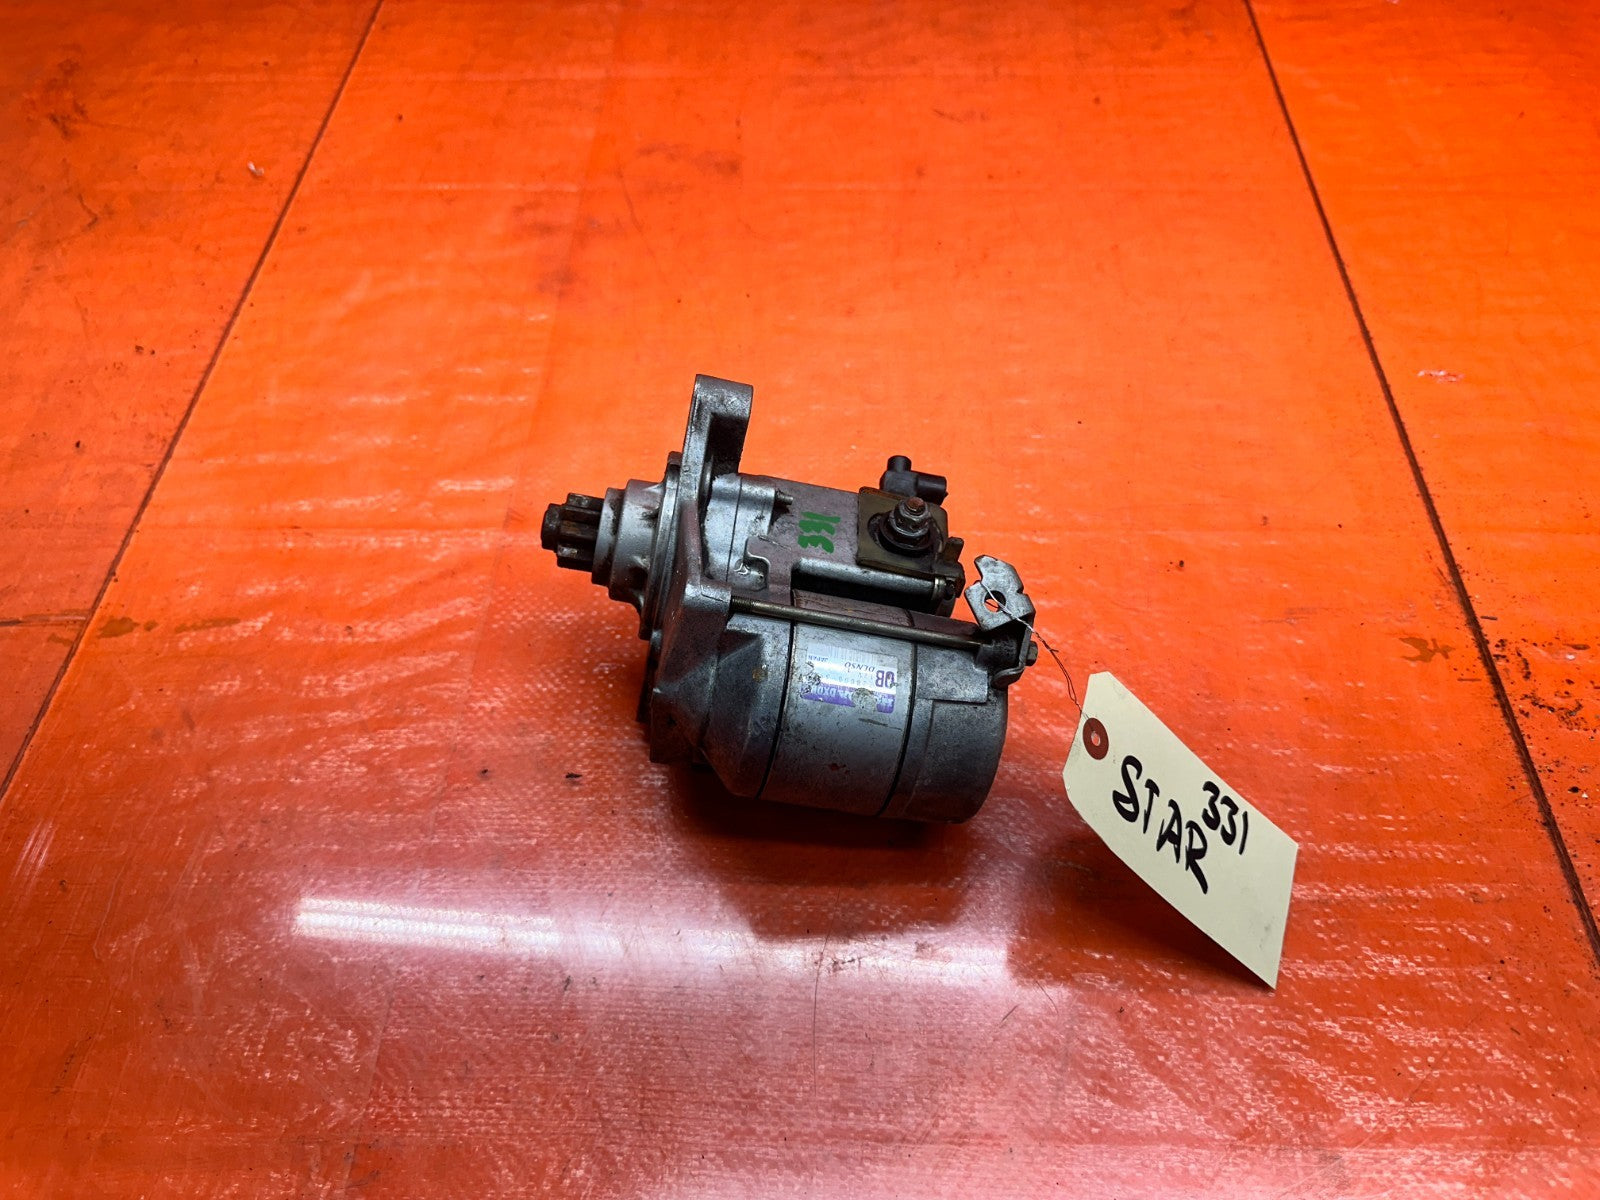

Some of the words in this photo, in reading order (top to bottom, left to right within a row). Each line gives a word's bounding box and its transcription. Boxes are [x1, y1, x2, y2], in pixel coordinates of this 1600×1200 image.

[844, 661, 875, 673] DENSO
[1112, 755, 1208, 894] STAR
[1202, 781, 1248, 855] 331
